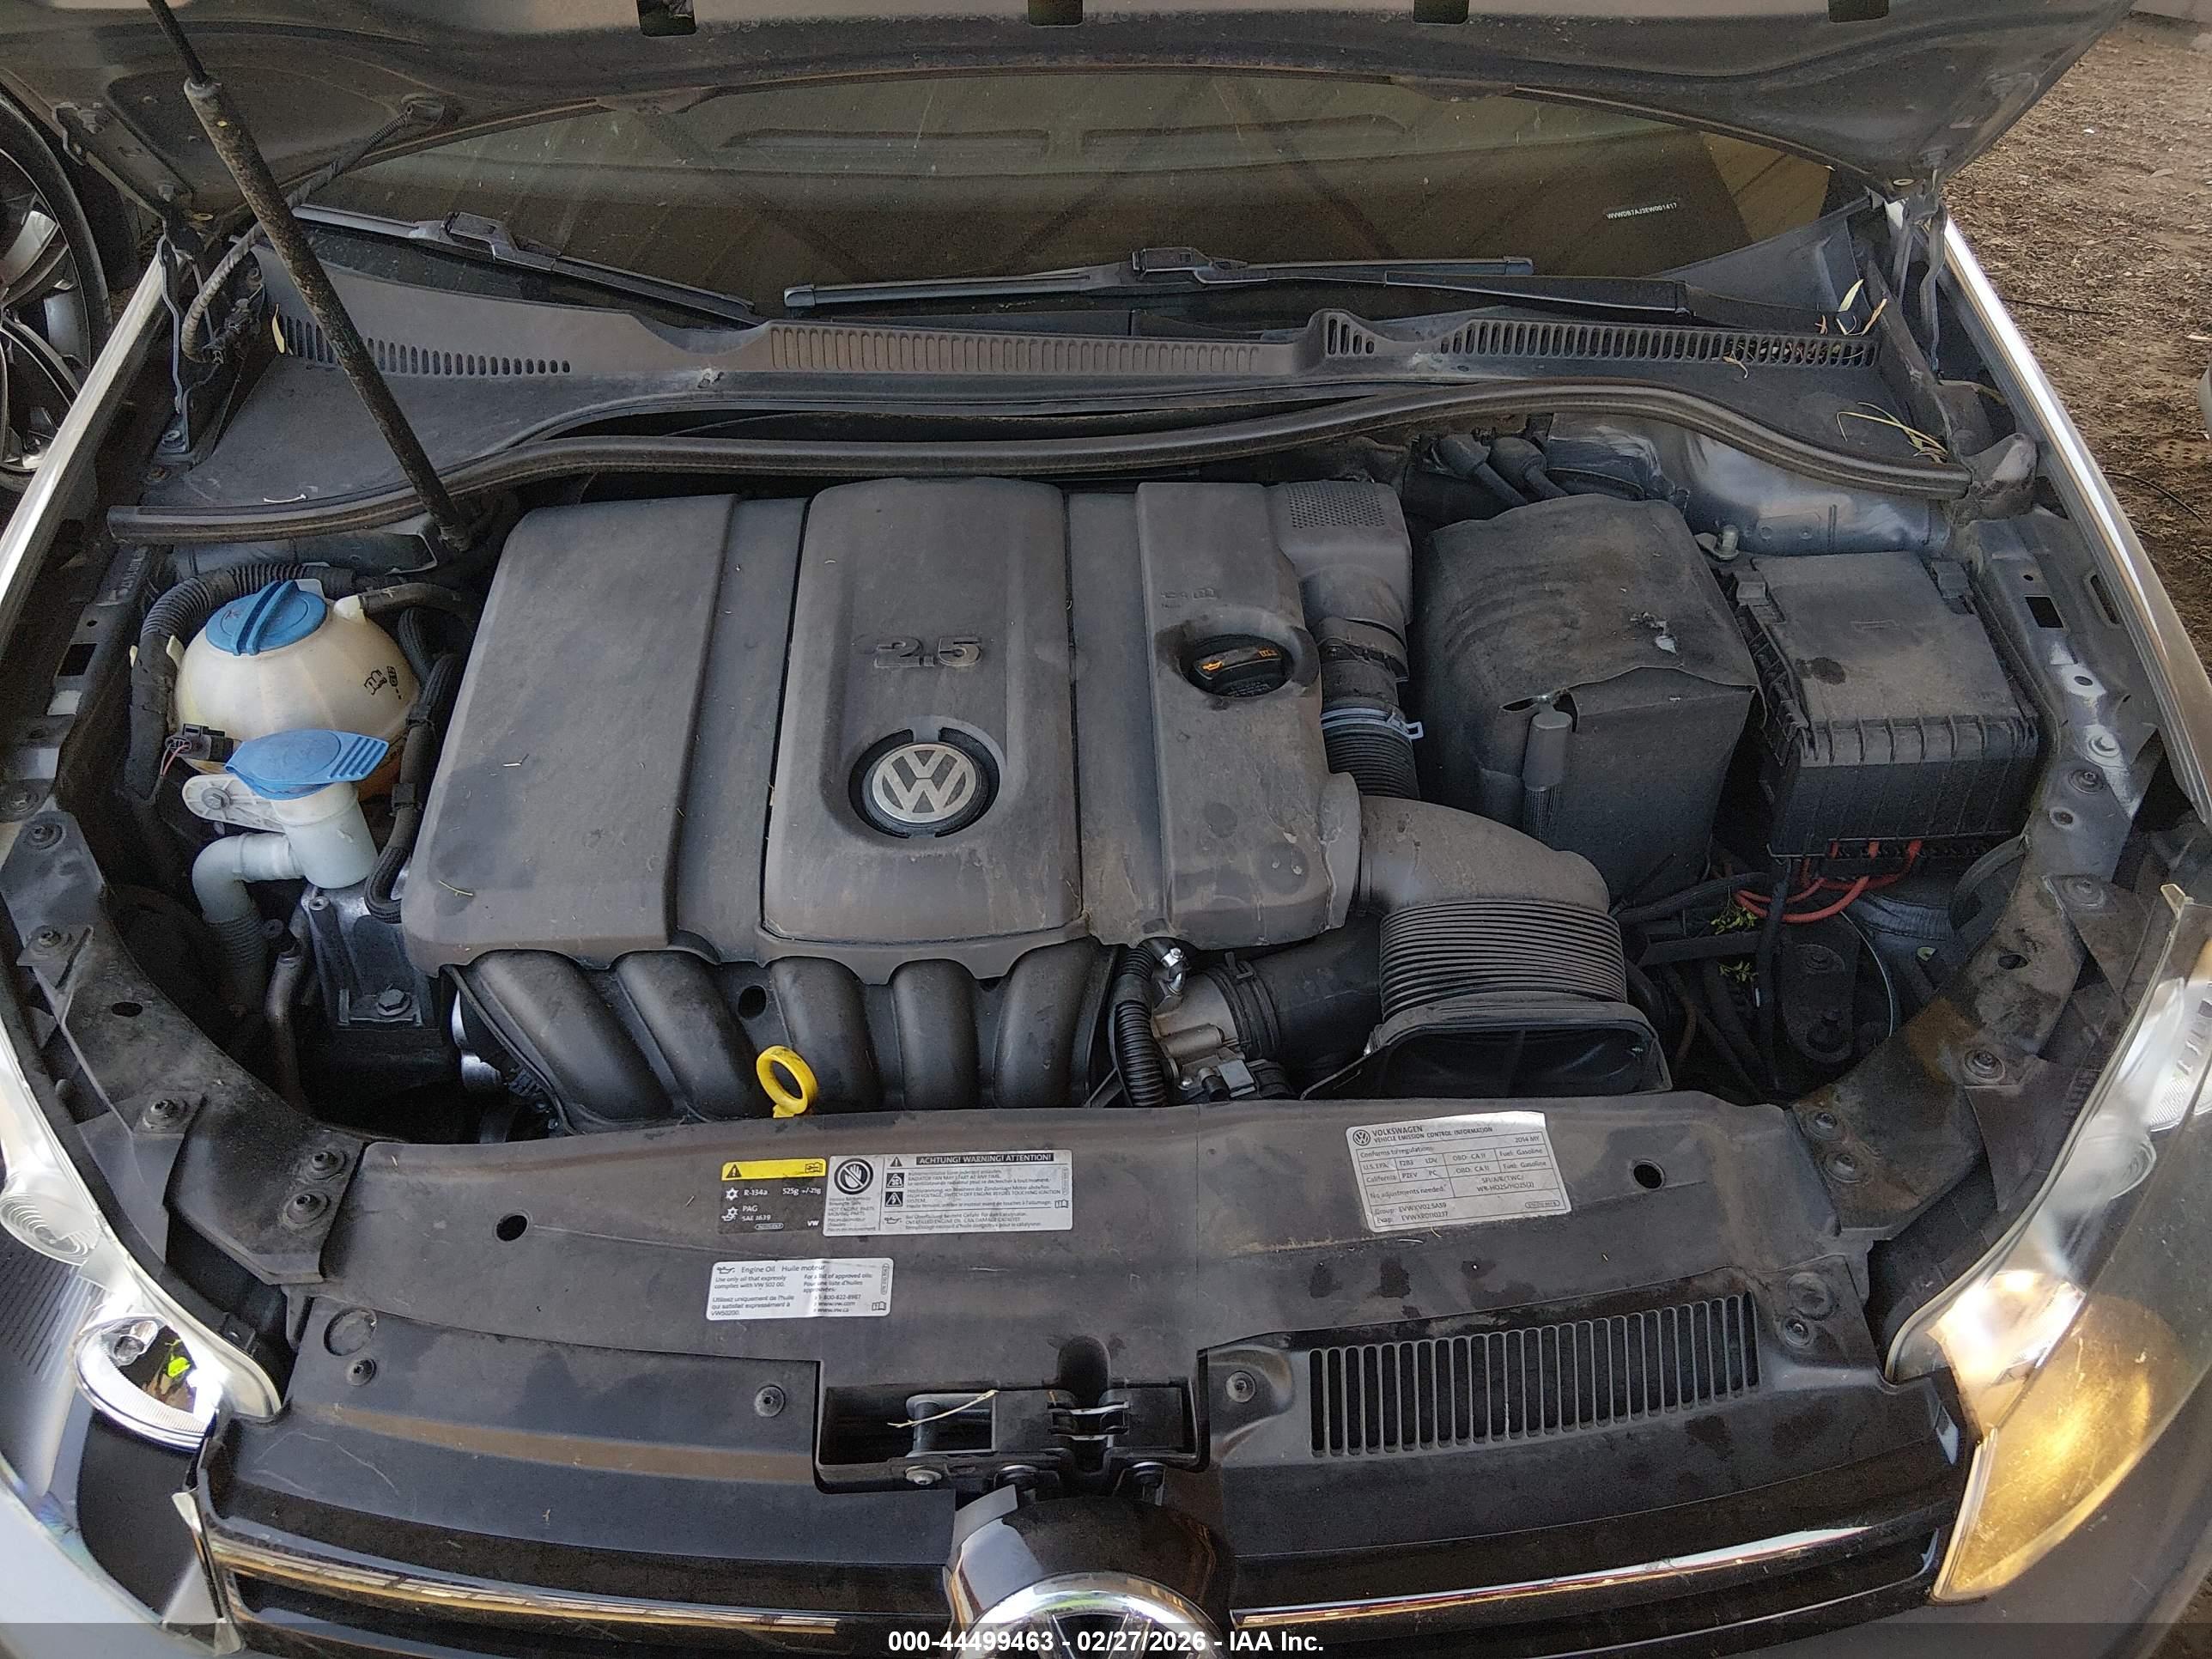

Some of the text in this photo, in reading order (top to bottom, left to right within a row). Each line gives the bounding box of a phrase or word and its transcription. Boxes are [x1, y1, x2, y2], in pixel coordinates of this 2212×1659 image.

[874, 636, 981, 667] 2.5
[1372, 1126, 1423, 1136] VOLKSWAGEN
[1006, 1153, 1051, 1162] ATTENTION!
